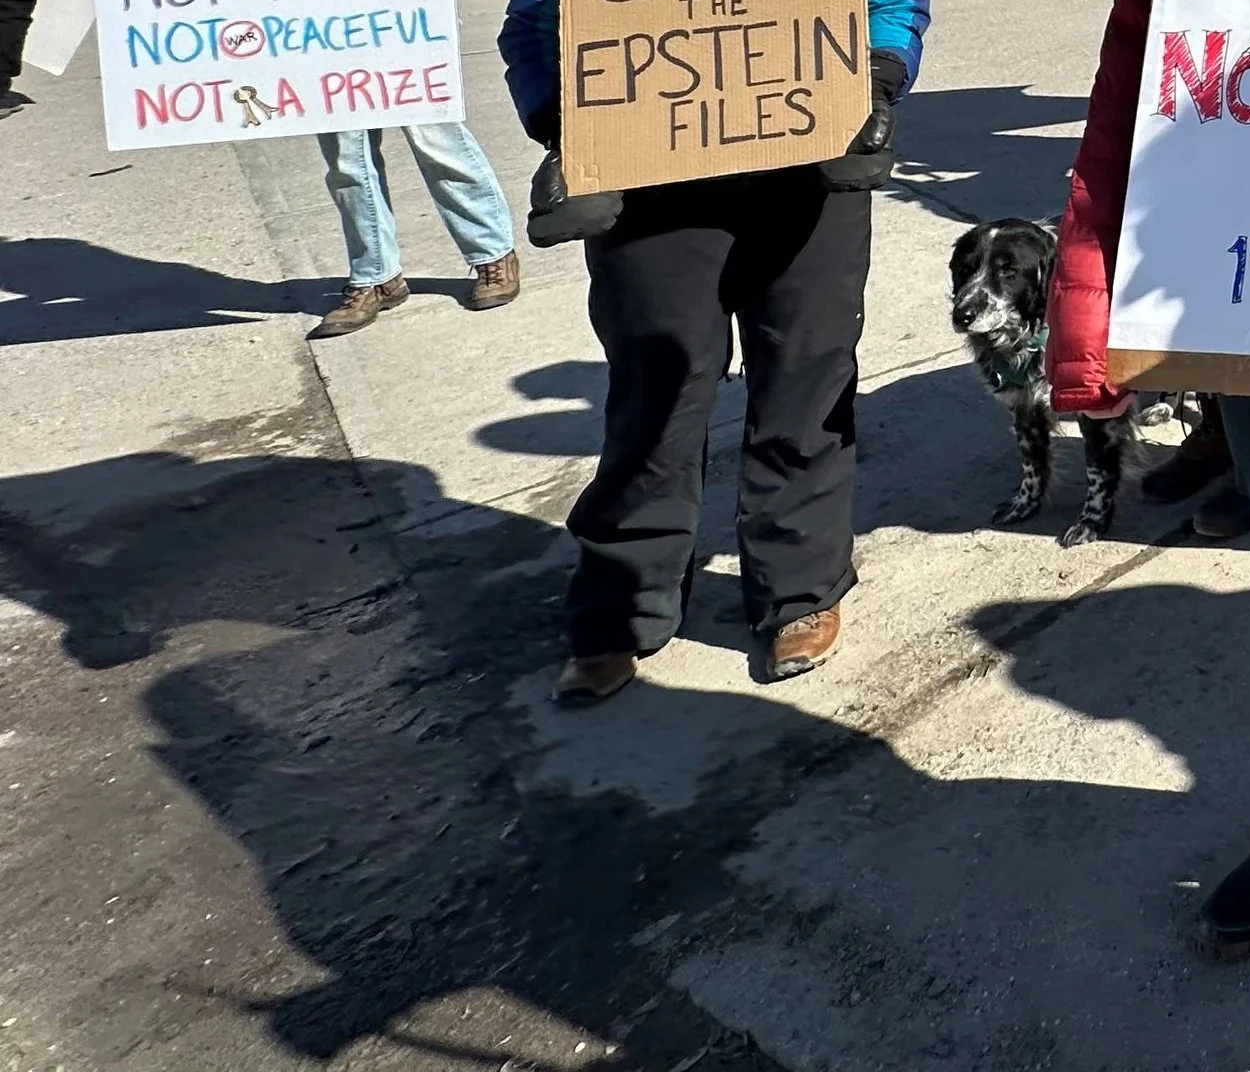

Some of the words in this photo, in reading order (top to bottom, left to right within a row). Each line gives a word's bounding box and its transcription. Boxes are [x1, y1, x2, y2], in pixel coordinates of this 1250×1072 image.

[126, 17, 227, 68] NOT
[262, 7, 447, 57] PEACEFUL
[225, 31, 257, 47] WAR
[577, 12, 858, 108] EPSTEIN
[135, 79, 233, 128] NOT
[275, 77, 305, 117] A
[320, 63, 452, 114] PRIZE
[671, 88, 816, 150] FILES
